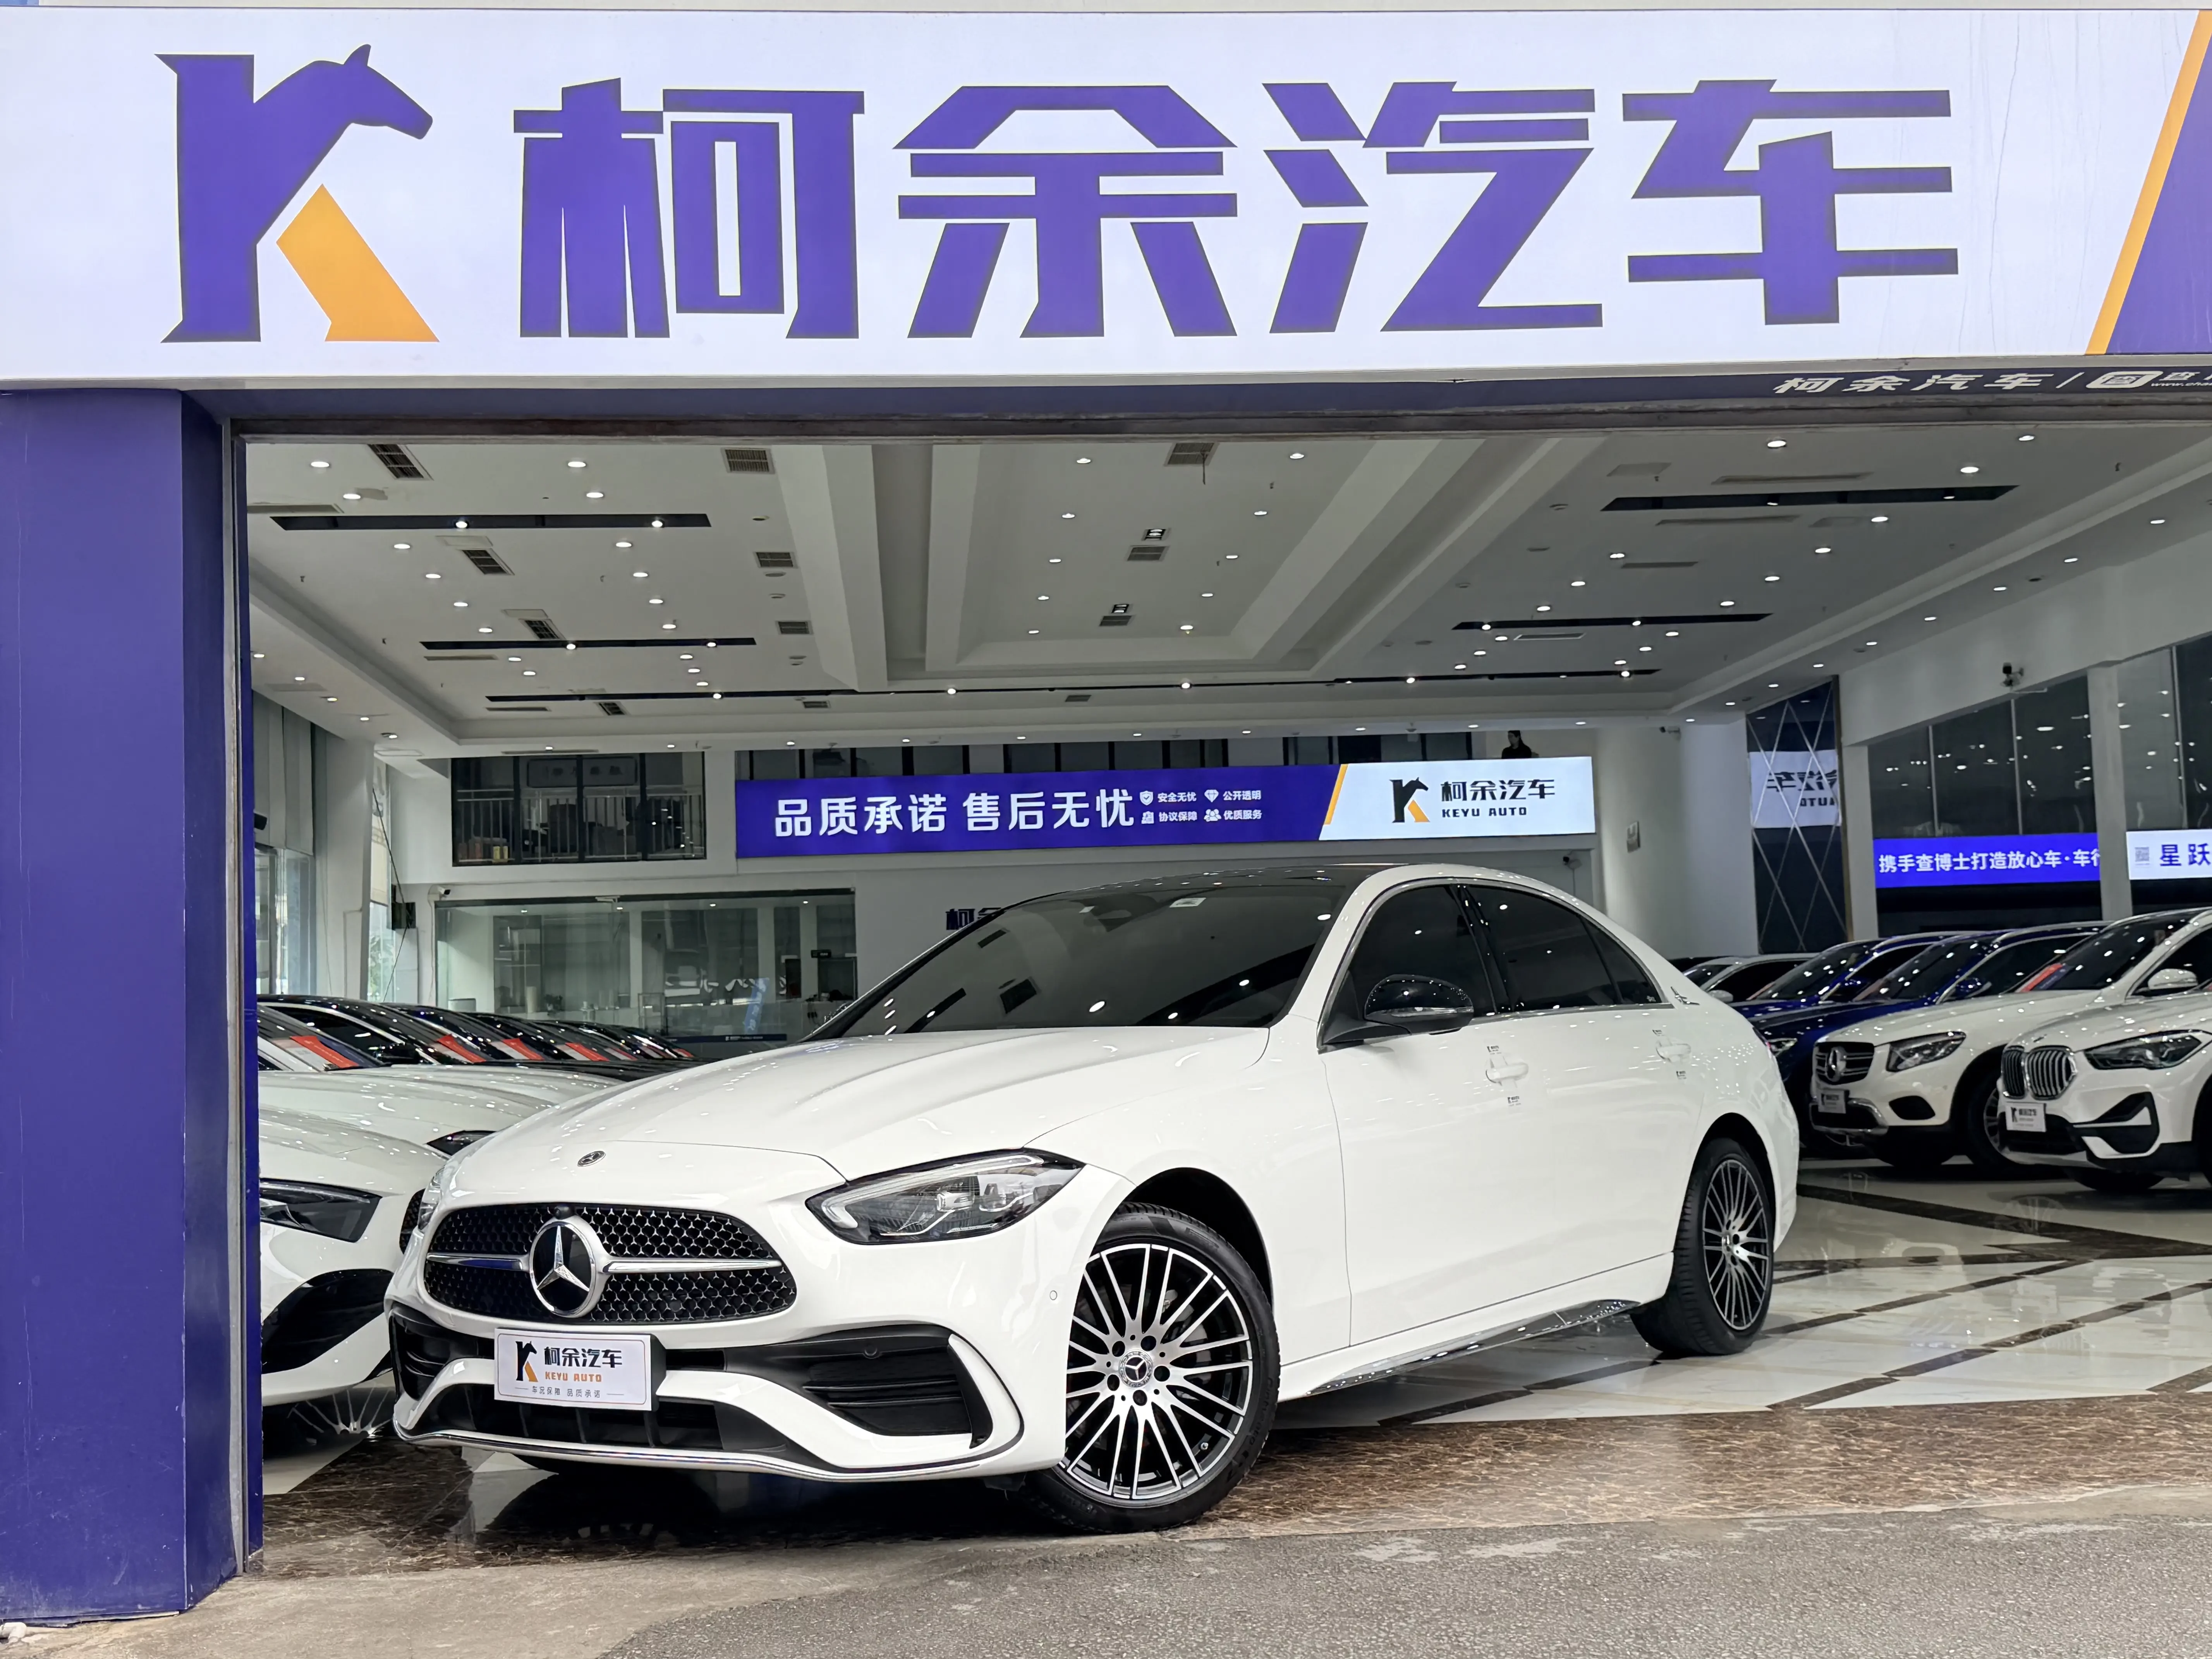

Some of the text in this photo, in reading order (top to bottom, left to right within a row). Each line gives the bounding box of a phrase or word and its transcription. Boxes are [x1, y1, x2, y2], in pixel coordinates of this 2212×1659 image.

[513, 77, 1958, 337] 柯余汽车
[1773, 373, 2054, 393] 柯余汽车
[2159, 371, 2212, 381] 查
[1223, 790, 1261, 800] 公开透明
[1441, 779, 1555, 802] 柯余汽车
[775, 788, 1134, 837] 品质承诺 售后无忧
[1159, 811, 1197, 822] 协议保障
[1224, 809, 1262, 820] 优质服务
[1442, 807, 1527, 817] KEYU AUTO
[2160, 843, 2211, 866] 星跃
[544, 1346, 622, 1368] 柯余汽车
[545, 1371, 602, 1382] KEYU AUTO
